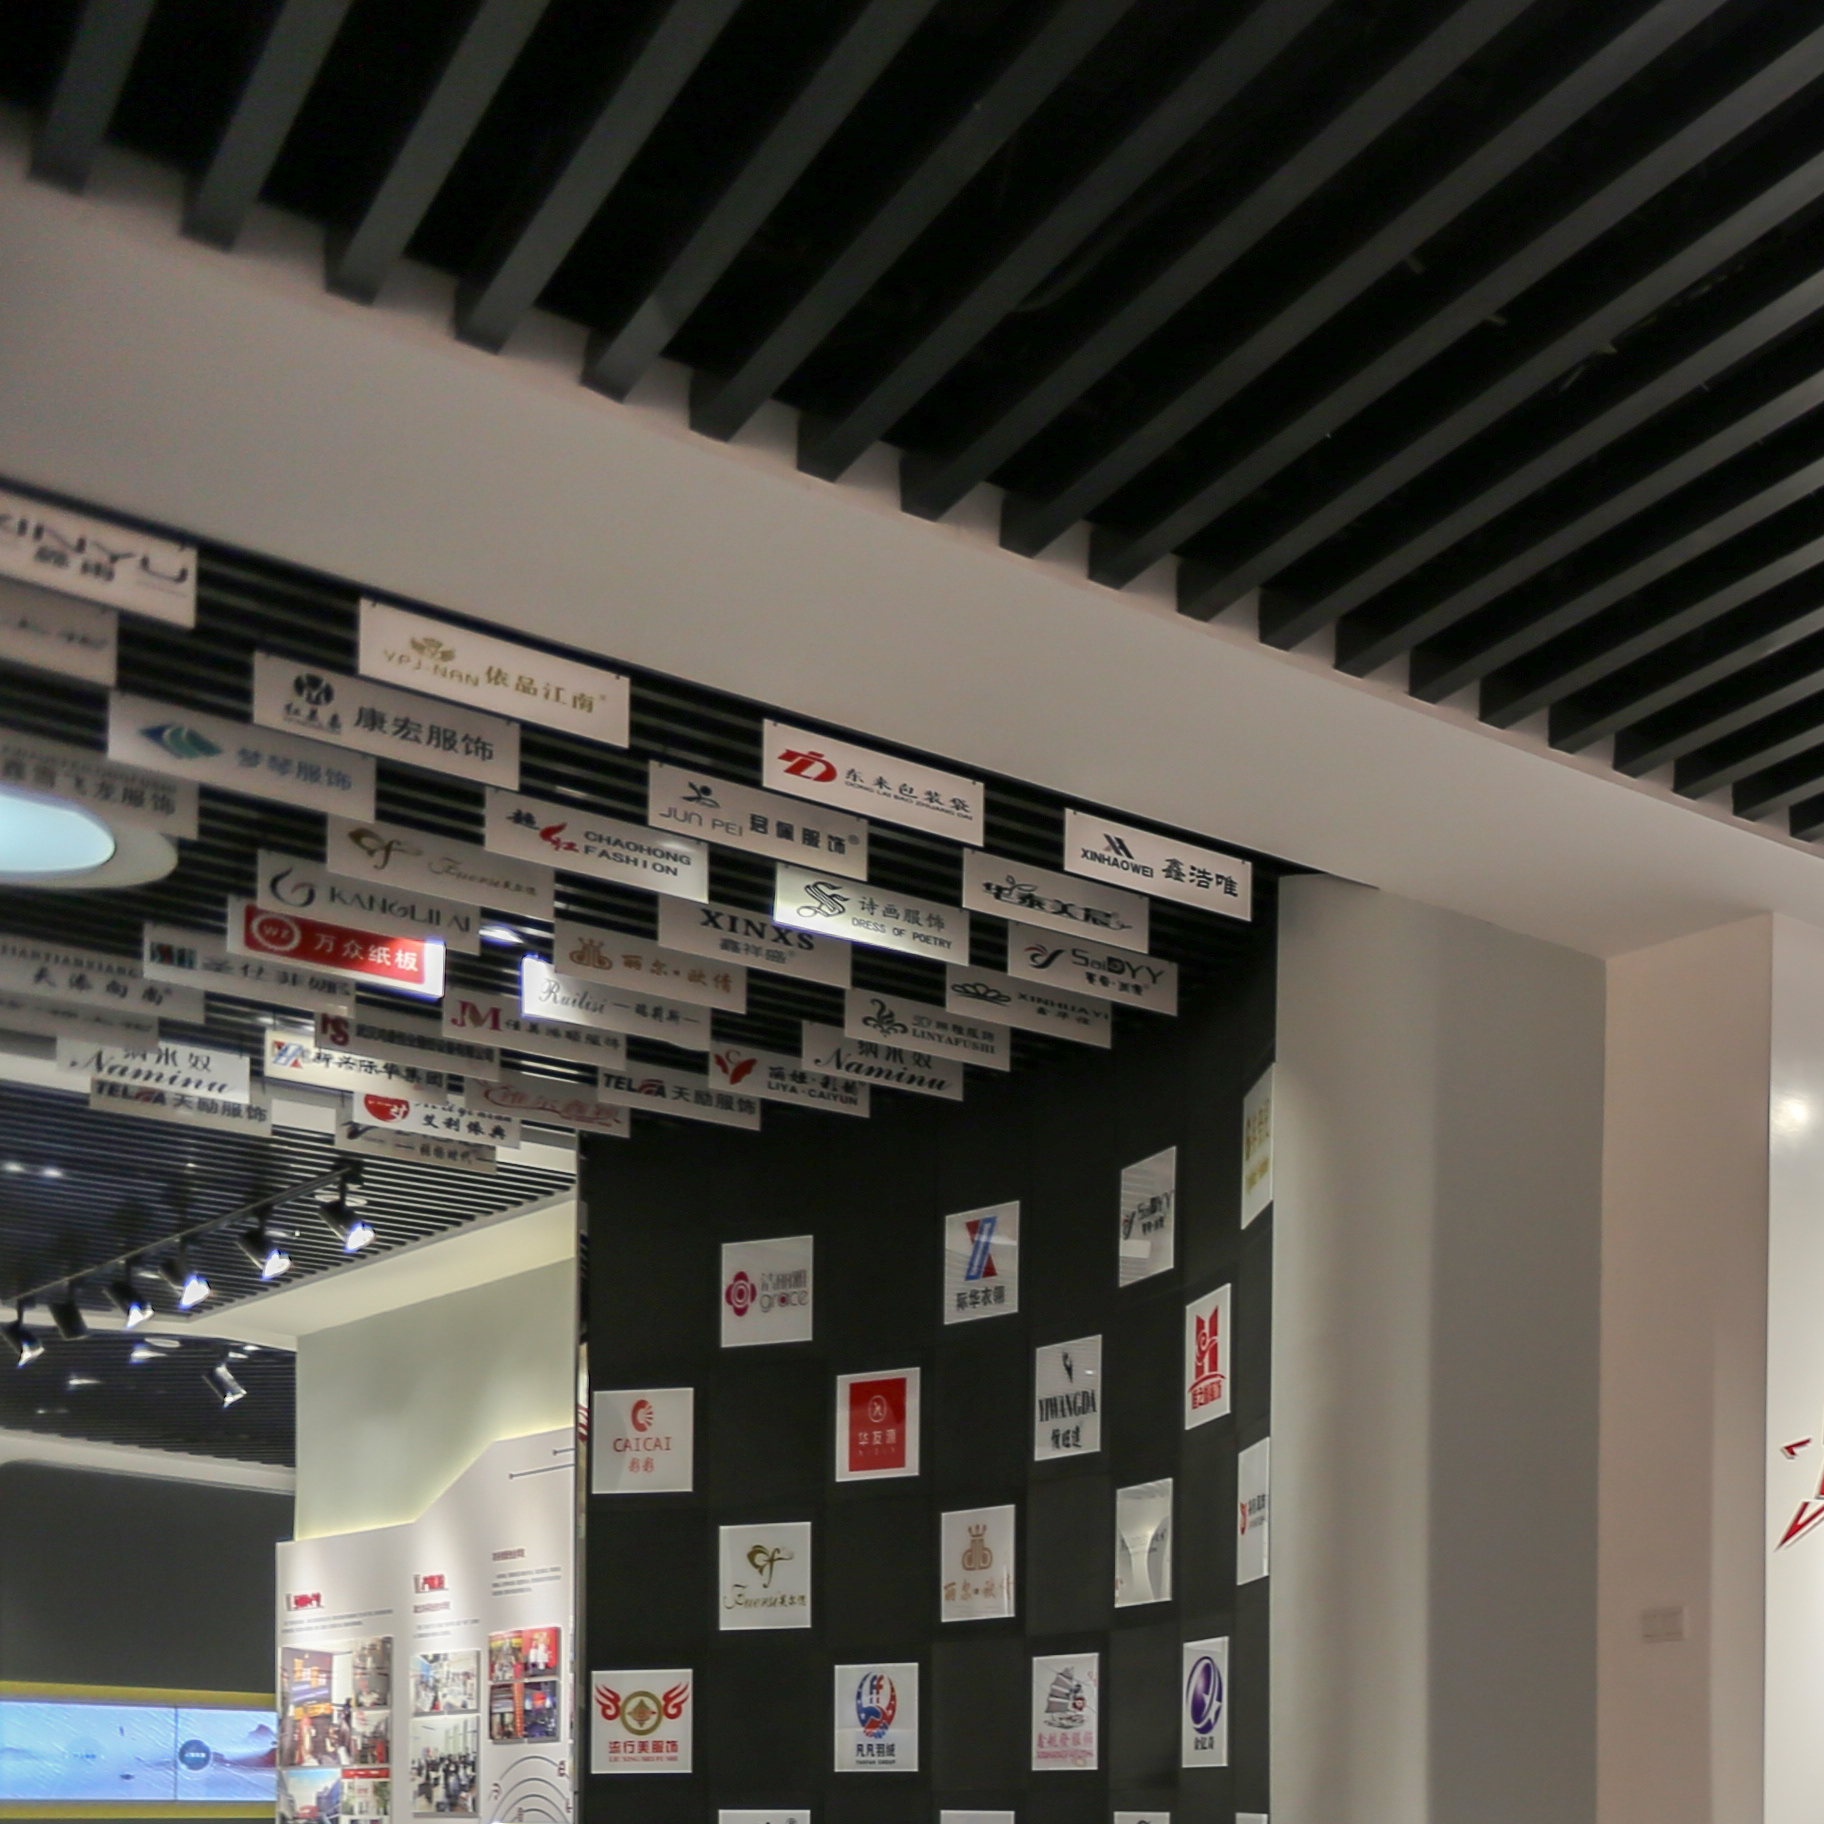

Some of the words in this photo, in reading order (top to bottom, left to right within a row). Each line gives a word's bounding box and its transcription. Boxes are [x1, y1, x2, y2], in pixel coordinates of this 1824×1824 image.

[484, 664, 595, 715] 依品江南
[353, 705, 496, 763] 康宏服饰
[844, 767, 970, 815] 东来包装袋
[659, 806, 703, 828] JUN
[711, 817, 743, 837] PEI
[583, 829, 692, 867] CHAOHONG
[583, 844, 679, 877] FASHION
[1081, 846, 1155, 879] XINHAOWEI
[1161, 856, 1239, 897] 鑫浩唯
[700, 908, 815, 952] XINXS
[858, 895, 946, 933] 诗画服饰
[850, 916, 887, 934] DRESS
[891, 926, 907, 939] OF
[911, 931, 952, 950] POETRY
[314, 930, 420, 974] 万众纸板
[911, 1029, 996, 1055] LINYAFUSHI
[670, 1085, 756, 1115] 天励服饰
[612, 1436, 672, 1453] CAICAI
[608, 1739, 679, 1755] 流行美服饰
